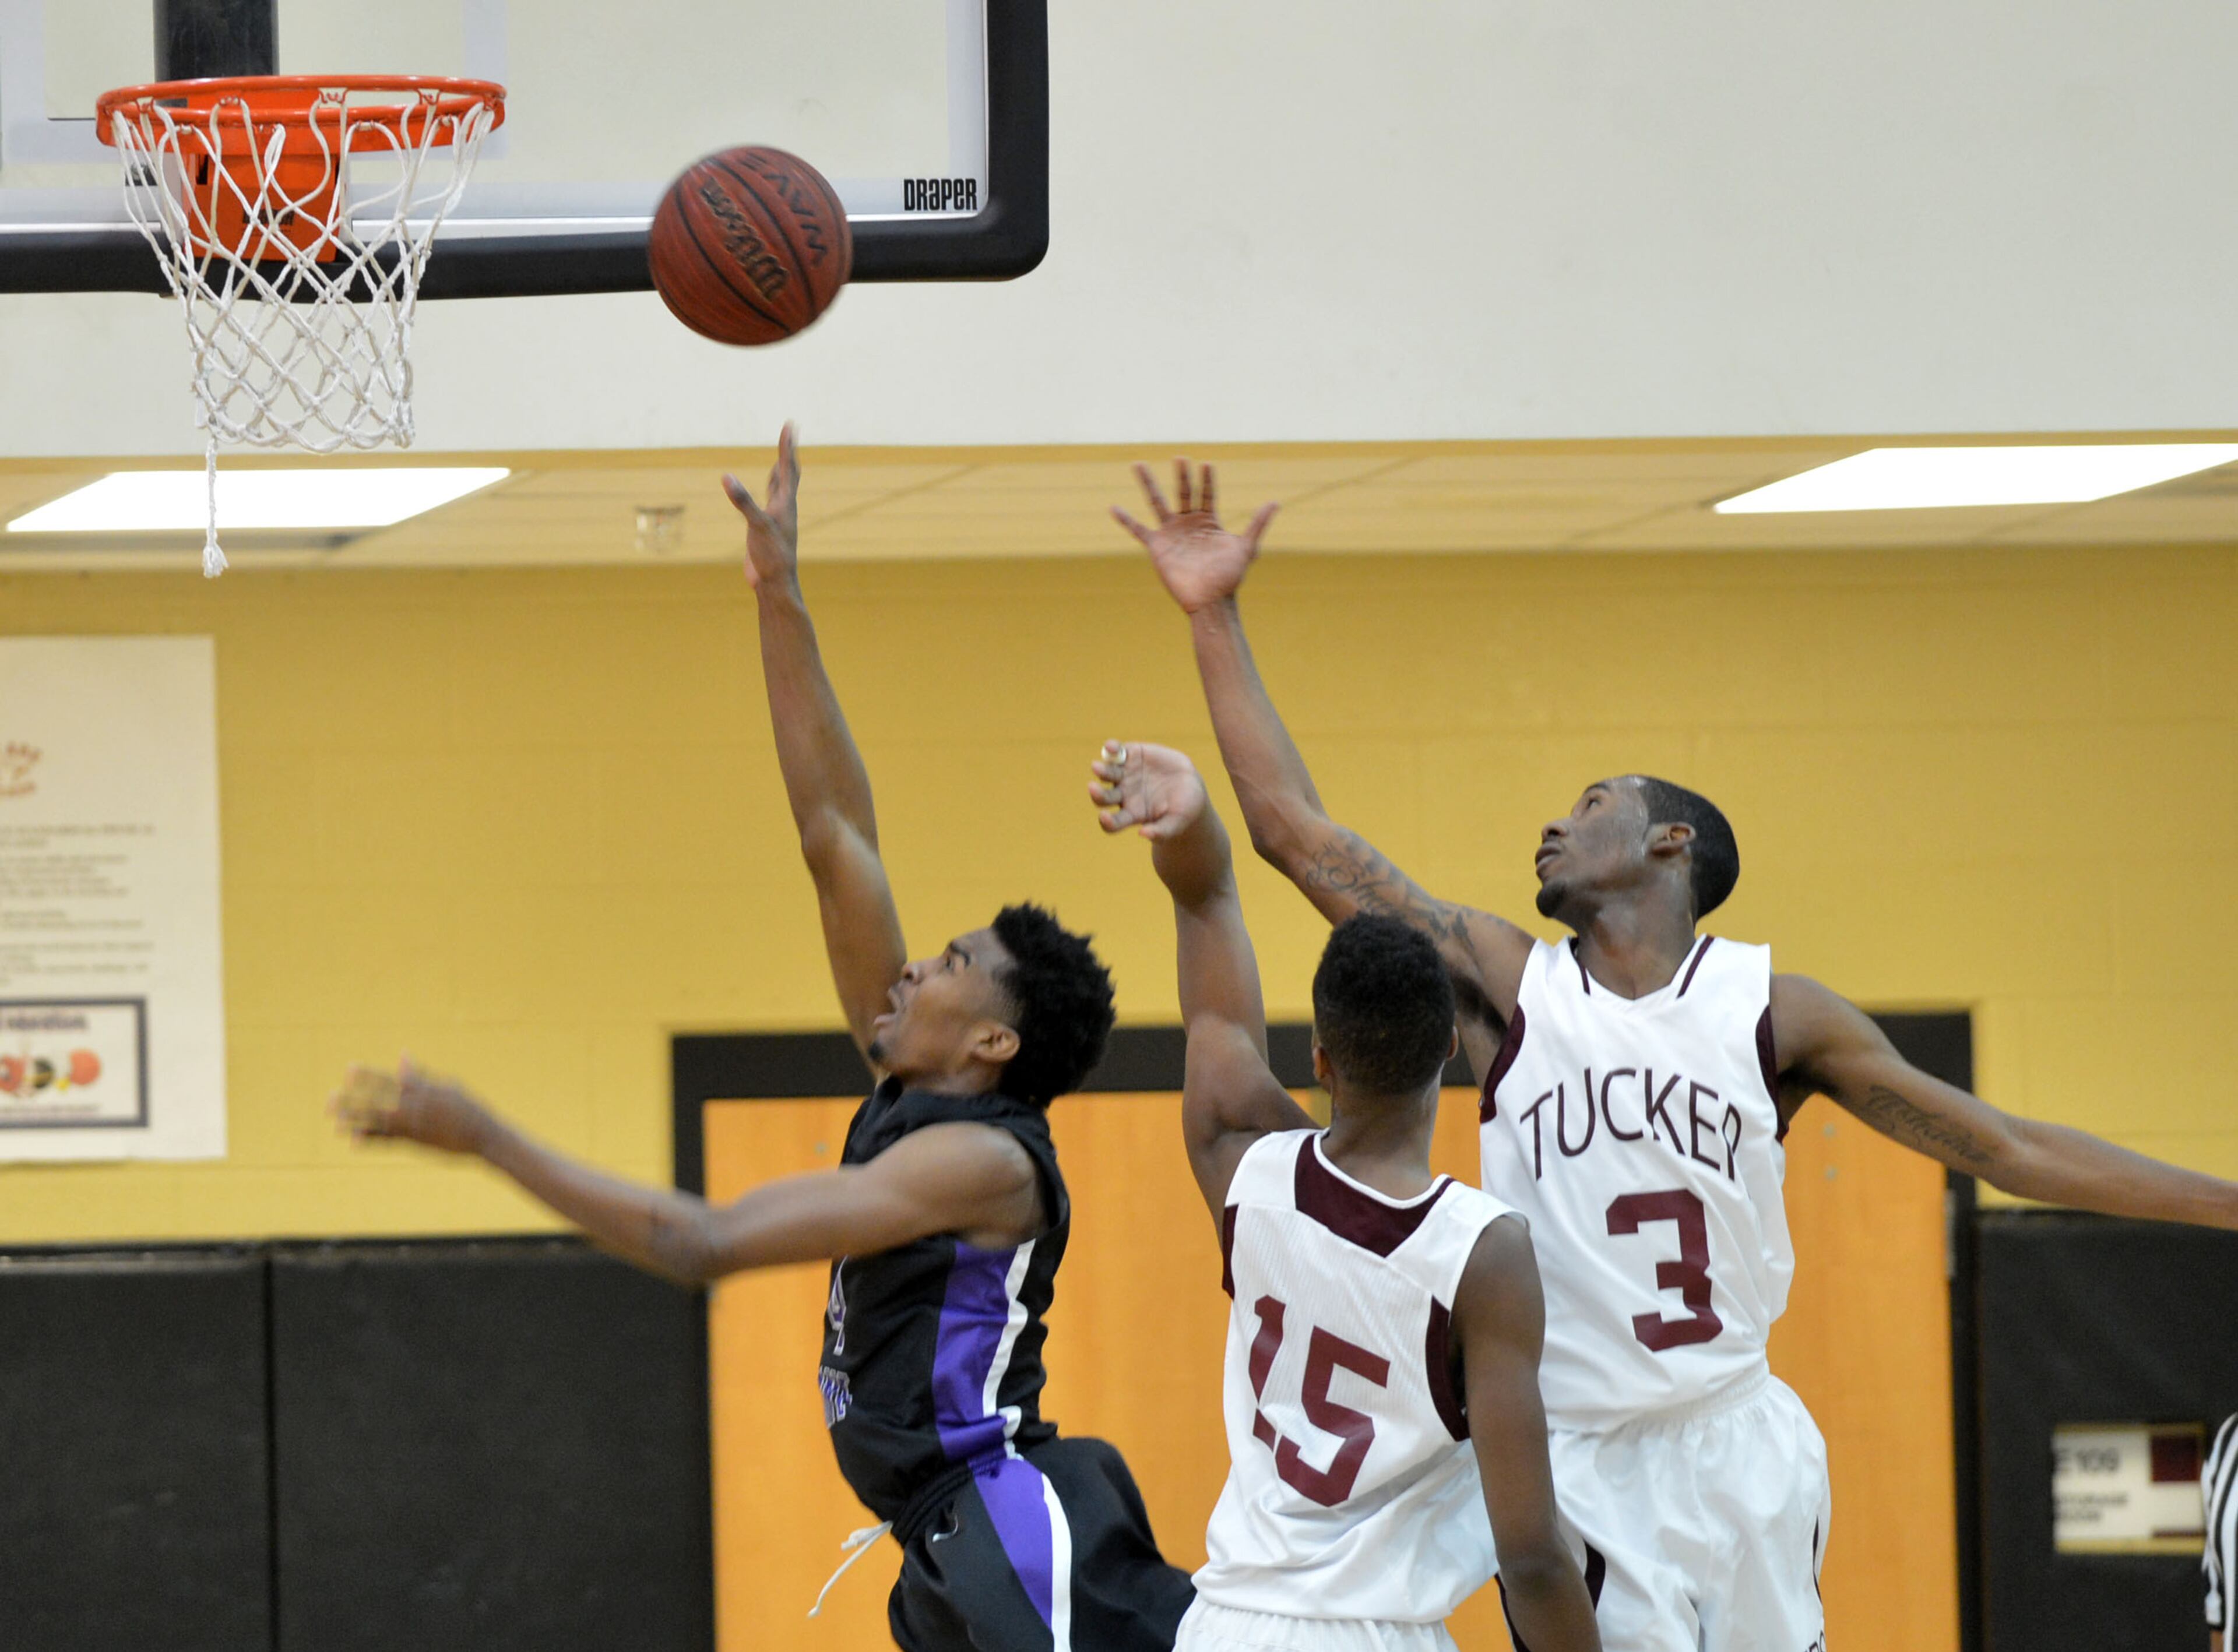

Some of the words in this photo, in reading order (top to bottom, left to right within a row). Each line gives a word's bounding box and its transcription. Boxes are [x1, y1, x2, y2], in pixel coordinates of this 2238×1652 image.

[700, 175, 790, 302] Wilson
[740, 152, 828, 268] WAVE
[1606, 1188, 1723, 1352] 3
[1248, 1294, 1391, 1508] 15
